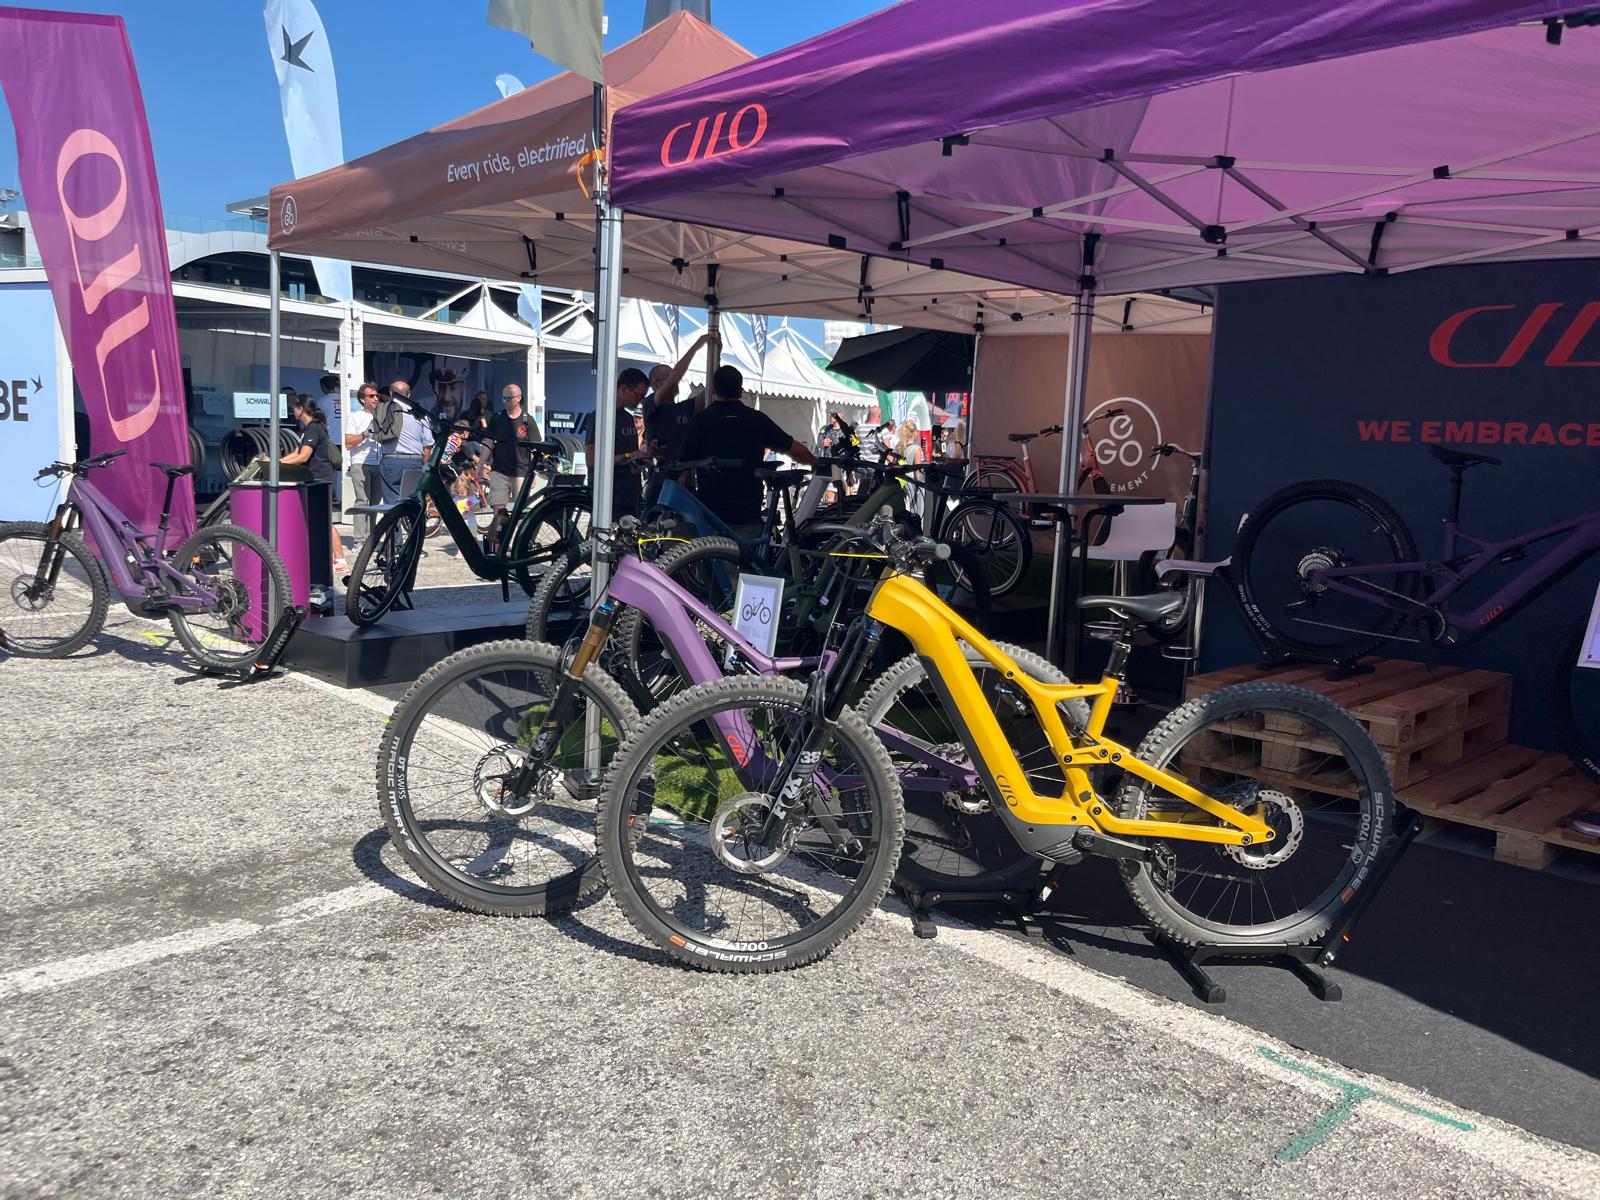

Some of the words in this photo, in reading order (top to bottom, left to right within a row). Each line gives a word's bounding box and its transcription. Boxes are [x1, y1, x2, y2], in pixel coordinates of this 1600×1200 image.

[447, 164, 480, 183] Every
[482, 153, 515, 174] ride,
[517, 133, 589, 168] electrified.
[245, 397, 271, 405] SCHWAL
[1357, 420, 1411, 443] WE
[1420, 421, 1600, 447] EMBRACE
[1094, 438, 1143, 467] GO
[1109, 471, 1149, 493] EMENT
[387, 736, 400, 788] MAGIC
[398, 755, 407, 772] DT
[397, 772, 408, 801] SWISS
[388, 790, 409, 837] MARY
[1359, 813, 1372, 841] 1700
[1351, 791, 1385, 891] SCHWALBE
[684, 942, 788, 963] SCHWALBE
[734, 941, 769, 952] 1700
